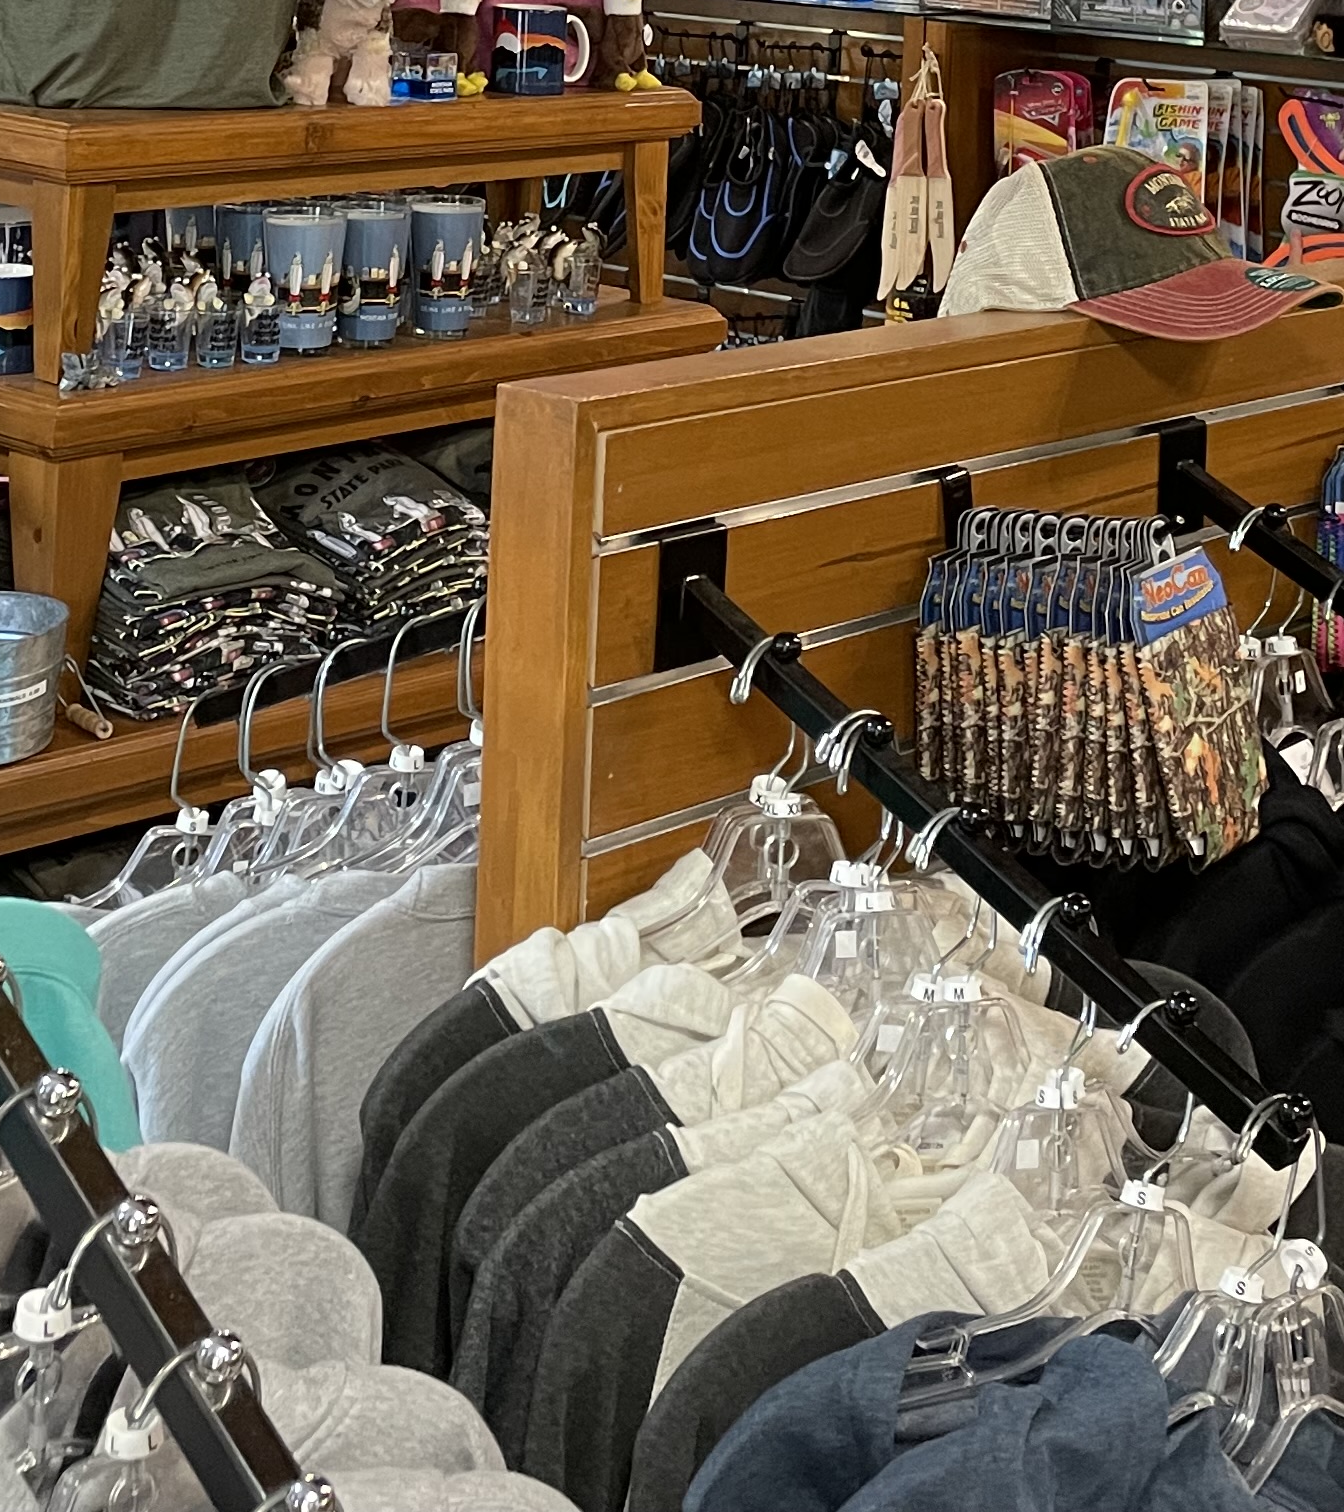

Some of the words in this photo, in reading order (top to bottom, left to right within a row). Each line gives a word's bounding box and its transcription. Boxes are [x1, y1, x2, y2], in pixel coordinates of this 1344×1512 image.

[1156, 117, 1201, 131] GAME
[319, 471, 369, 511] STATE
[1141, 563, 1210, 609] NeoCan
[922, 988, 936, 1002] M
[953, 986, 965, 1001] M
[1038, 1089, 1046, 1104] S
[1136, 1190, 1146, 1206] S
[1306, 1244, 1316, 1257] S
[1235, 1280, 1246, 1296] S
[43, 1320, 54, 1339] L
